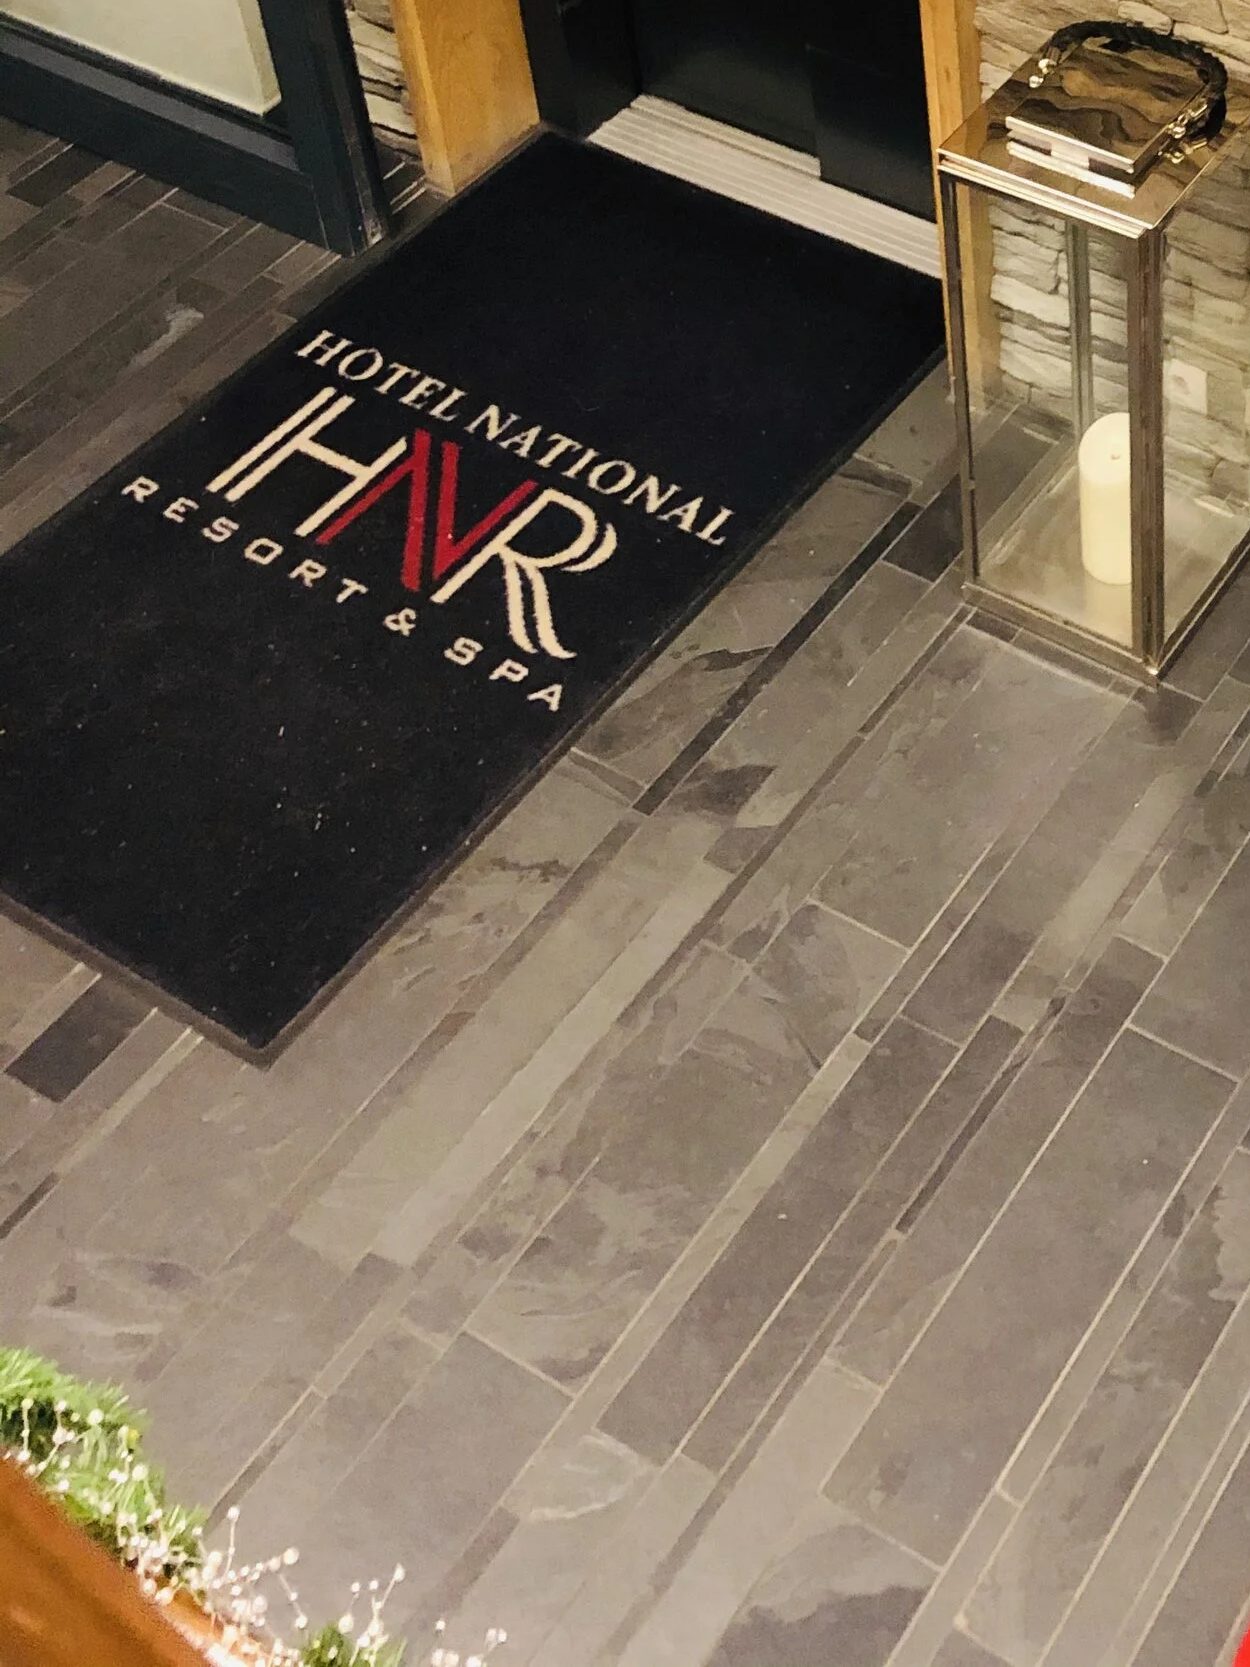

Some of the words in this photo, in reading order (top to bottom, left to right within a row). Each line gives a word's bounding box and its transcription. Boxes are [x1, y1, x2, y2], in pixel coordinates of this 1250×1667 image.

[207, 386, 617, 659] HNR
[297, 330, 466, 420] HOTEL
[468, 404, 736, 545] NATIONAL
[122, 475, 367, 603] RESORT
[383, 608, 417, 637] &
[444, 638, 564, 712] SPA
